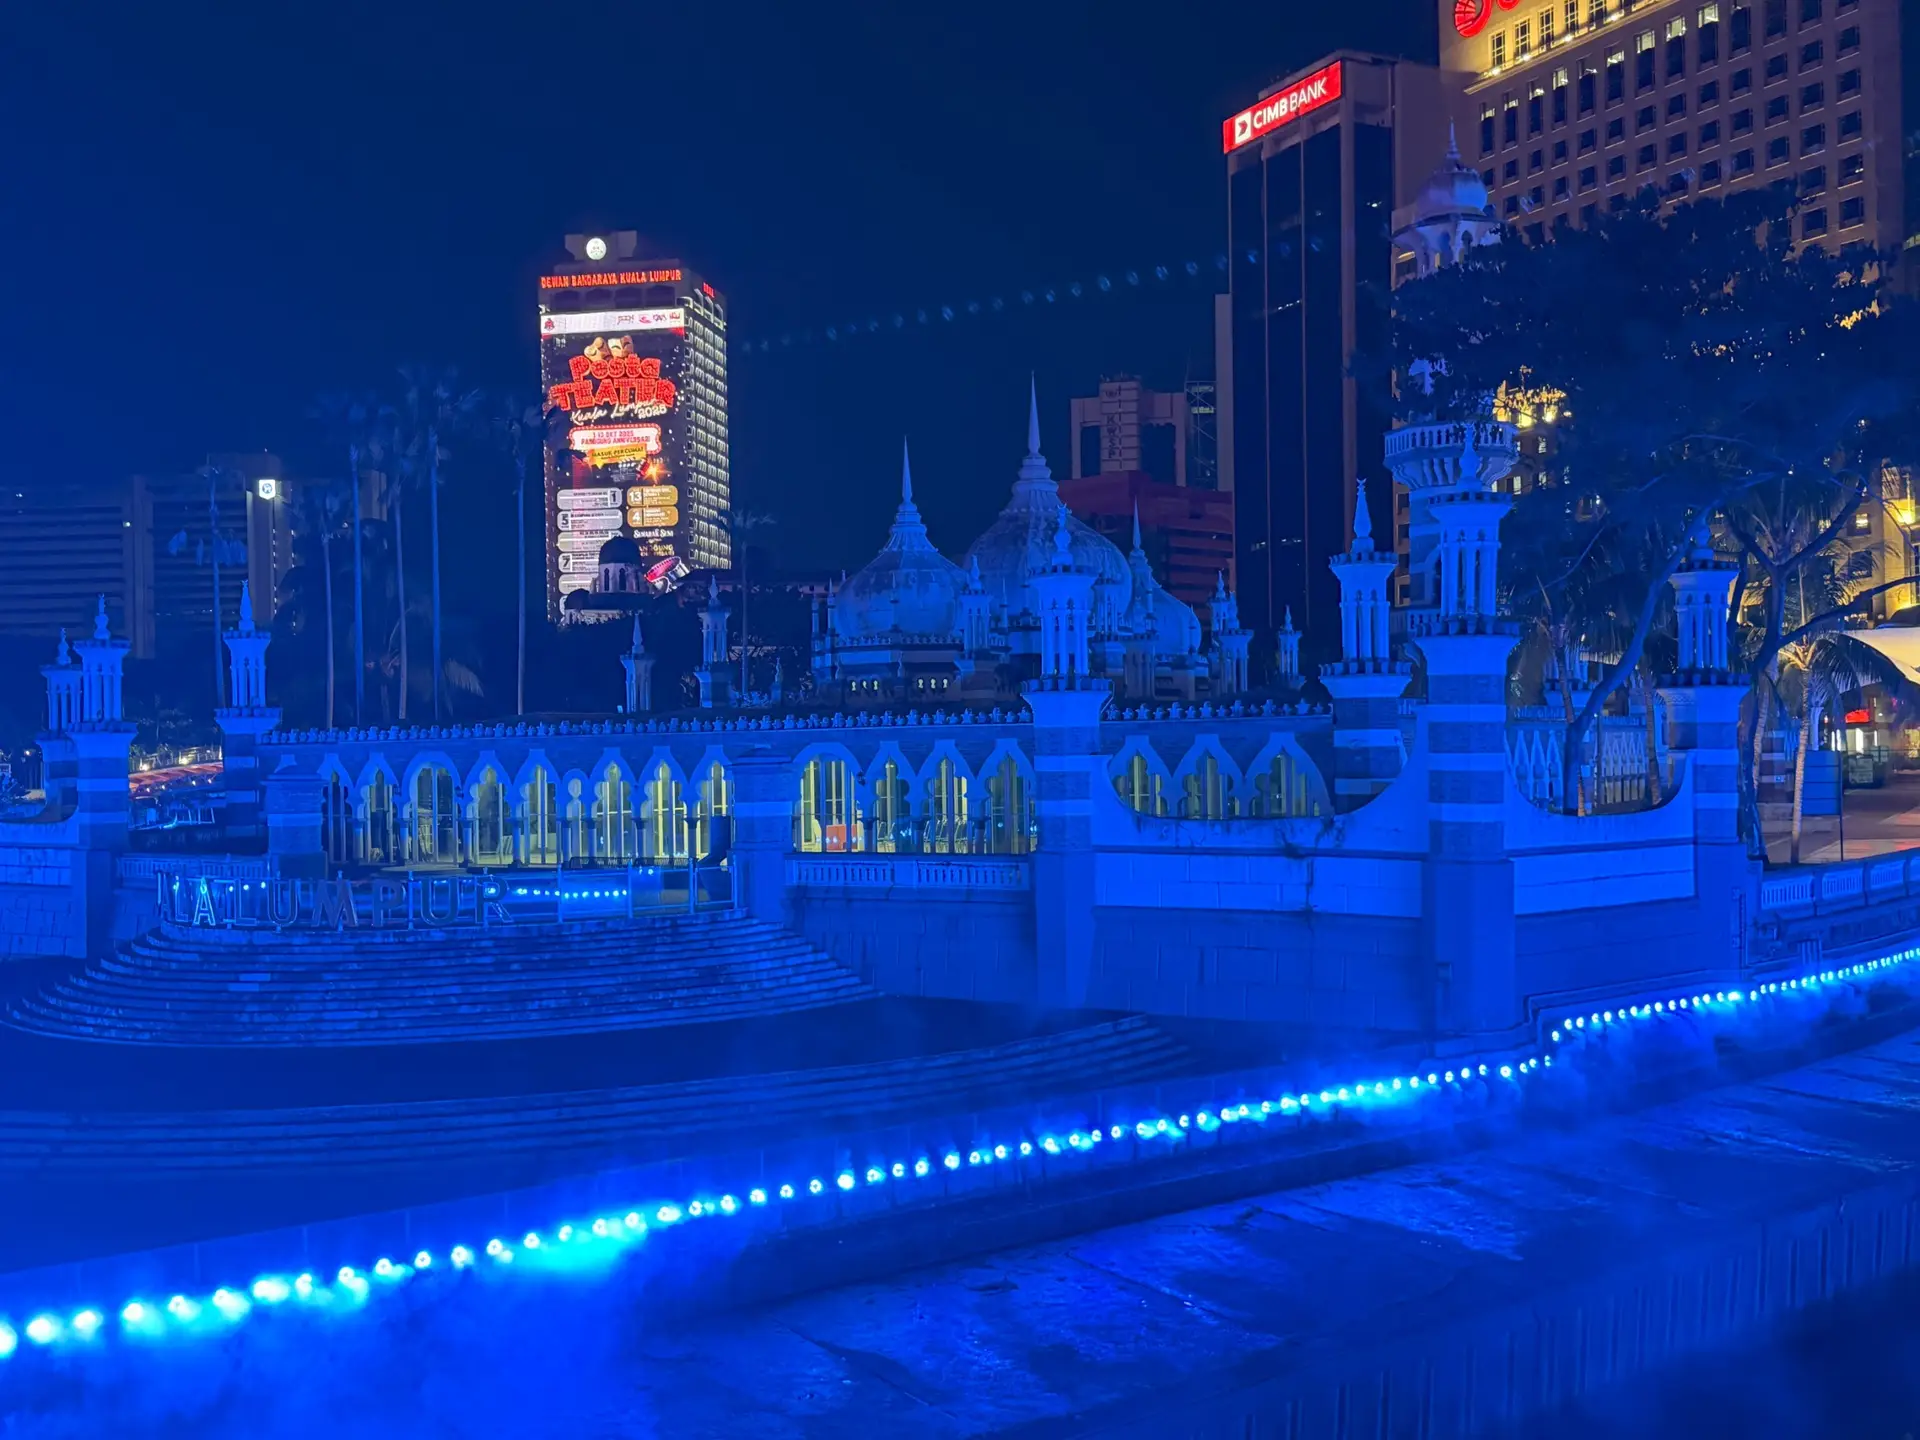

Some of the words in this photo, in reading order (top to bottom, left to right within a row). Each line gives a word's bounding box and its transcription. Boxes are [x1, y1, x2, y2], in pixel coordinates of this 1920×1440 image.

[1253, 97, 1288, 129] CIMB
[1289, 77, 1327, 112] BANK
[540, 275, 569, 288] DEWAN
[571, 273, 618, 287] BANDARAYA
[620, 271, 646, 284] KUALA
[649, 269, 681, 283] LUMPUR
[550, 377, 676, 411] TEATER
[570, 407, 608, 426] Kuala
[234, 874, 514, 928] LUMPUR
